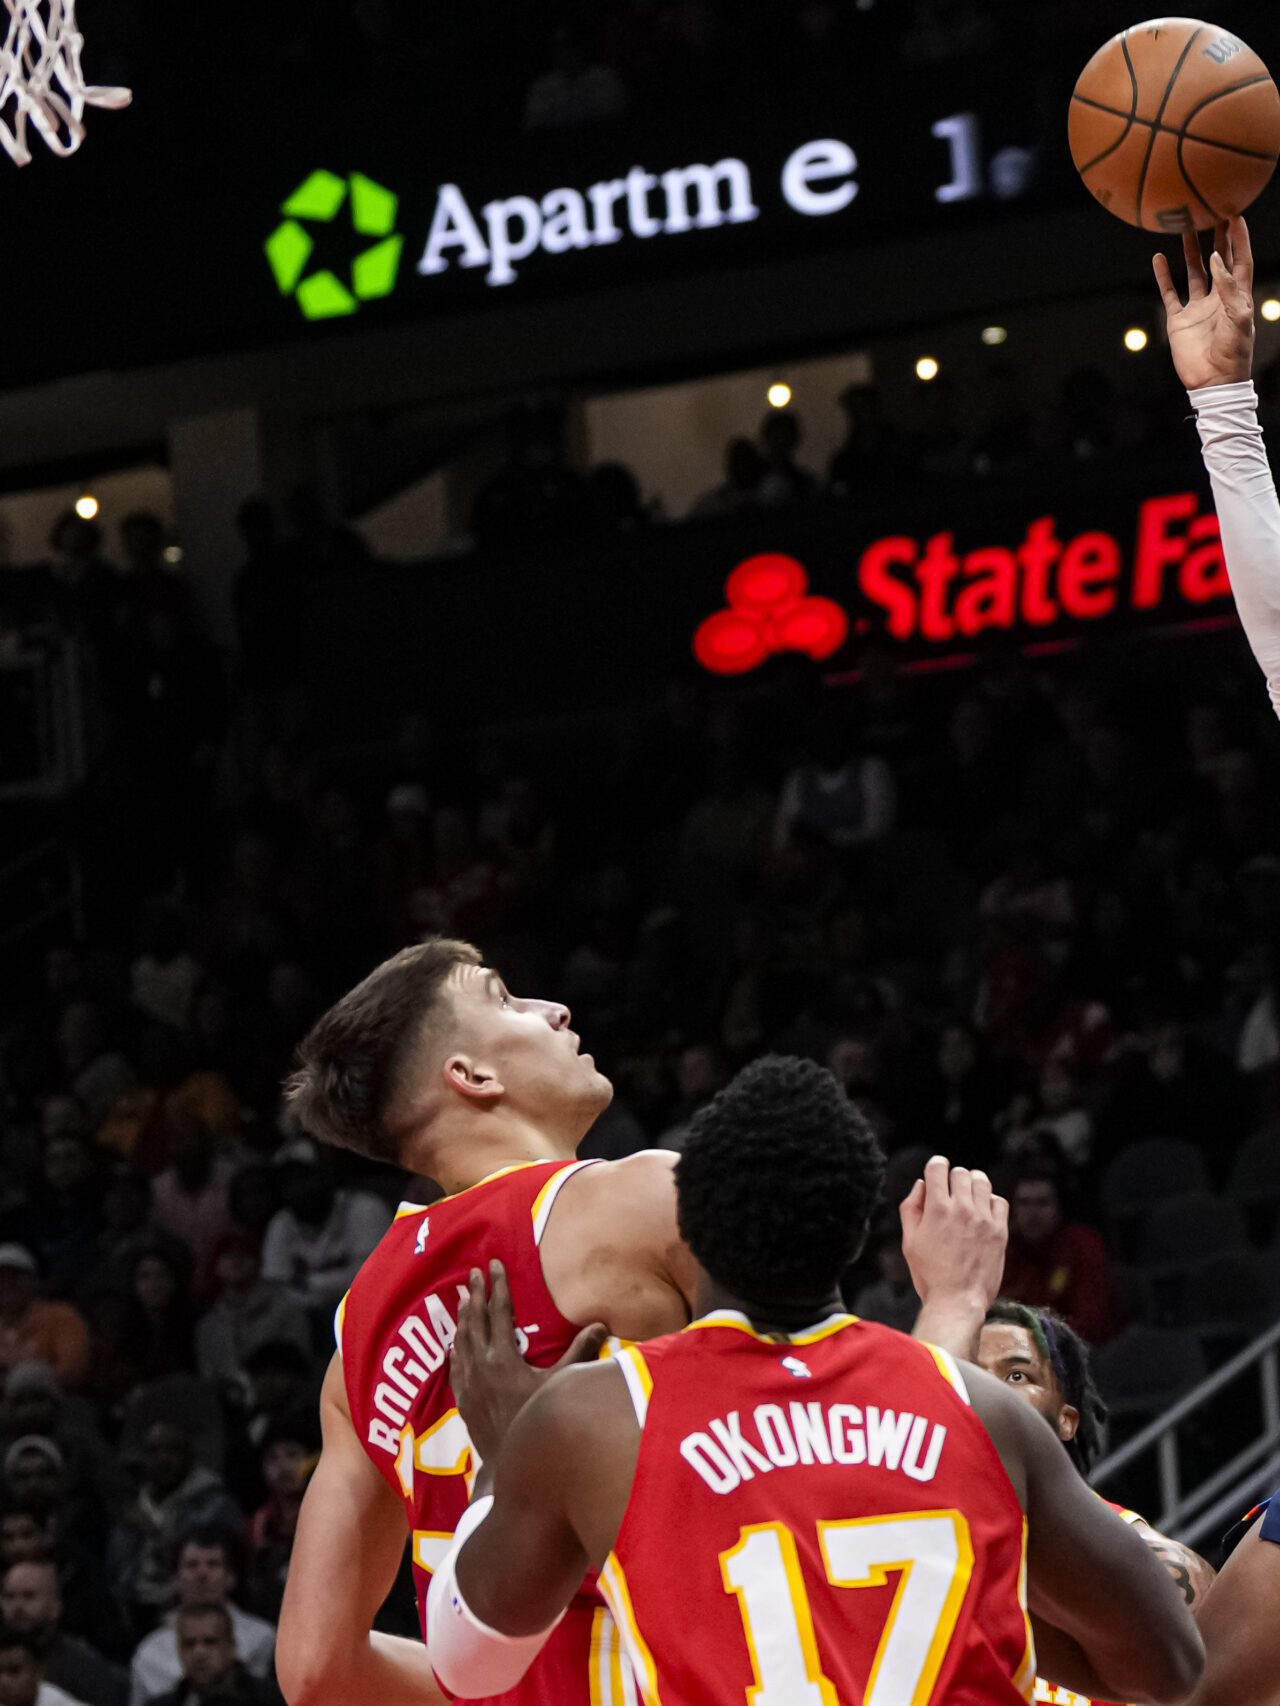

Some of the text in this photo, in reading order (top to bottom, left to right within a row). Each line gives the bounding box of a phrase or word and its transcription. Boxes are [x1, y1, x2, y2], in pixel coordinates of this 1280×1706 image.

[857, 515, 1121, 641] State
[679, 1401, 948, 1496] OKONGWU
[718, 1508, 976, 1706] 17
